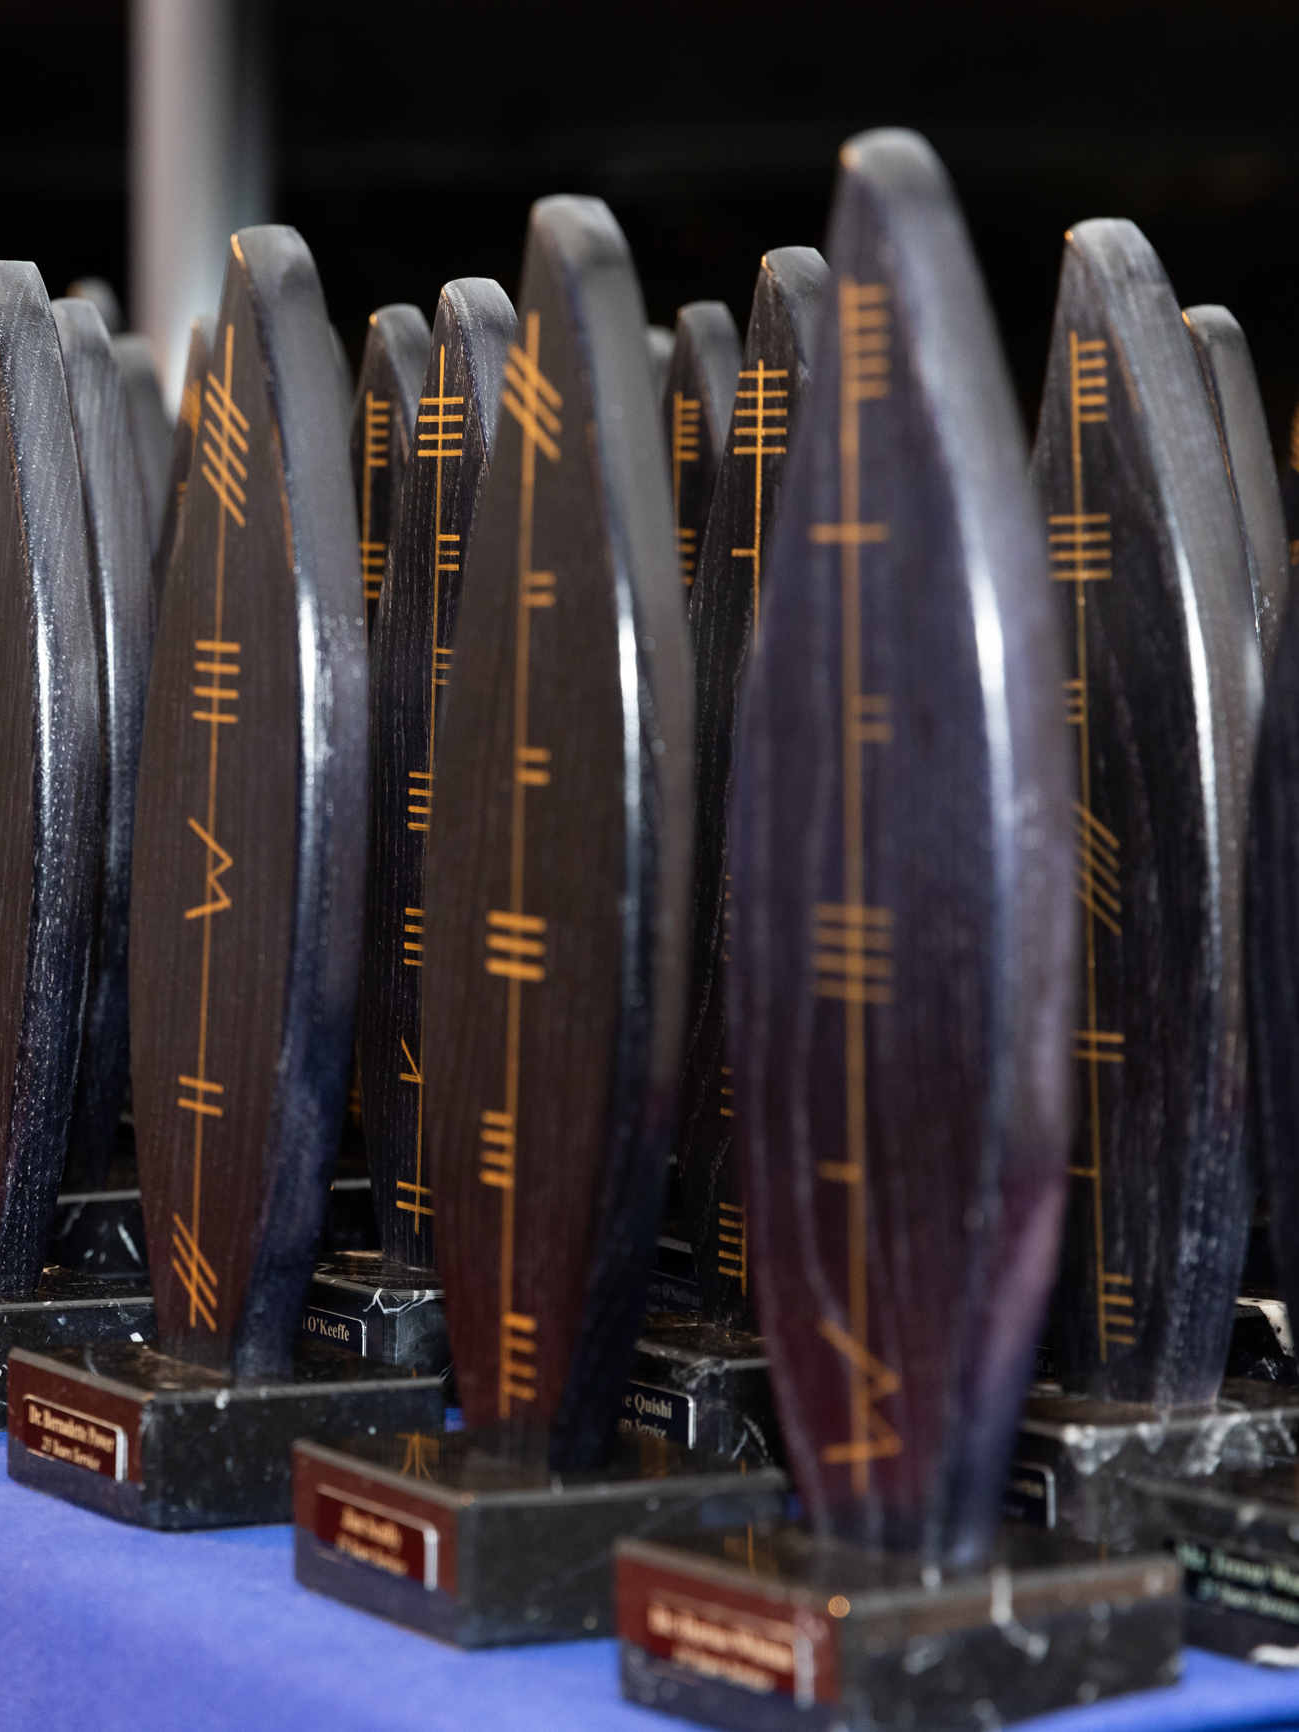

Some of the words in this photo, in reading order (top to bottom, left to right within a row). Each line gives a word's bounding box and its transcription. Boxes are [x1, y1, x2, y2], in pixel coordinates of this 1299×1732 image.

[307, 1316, 350, 1342] O'Keeffe
[634, 1392, 672, 1420] Quishi
[635, 1417, 667, 1440] Service
